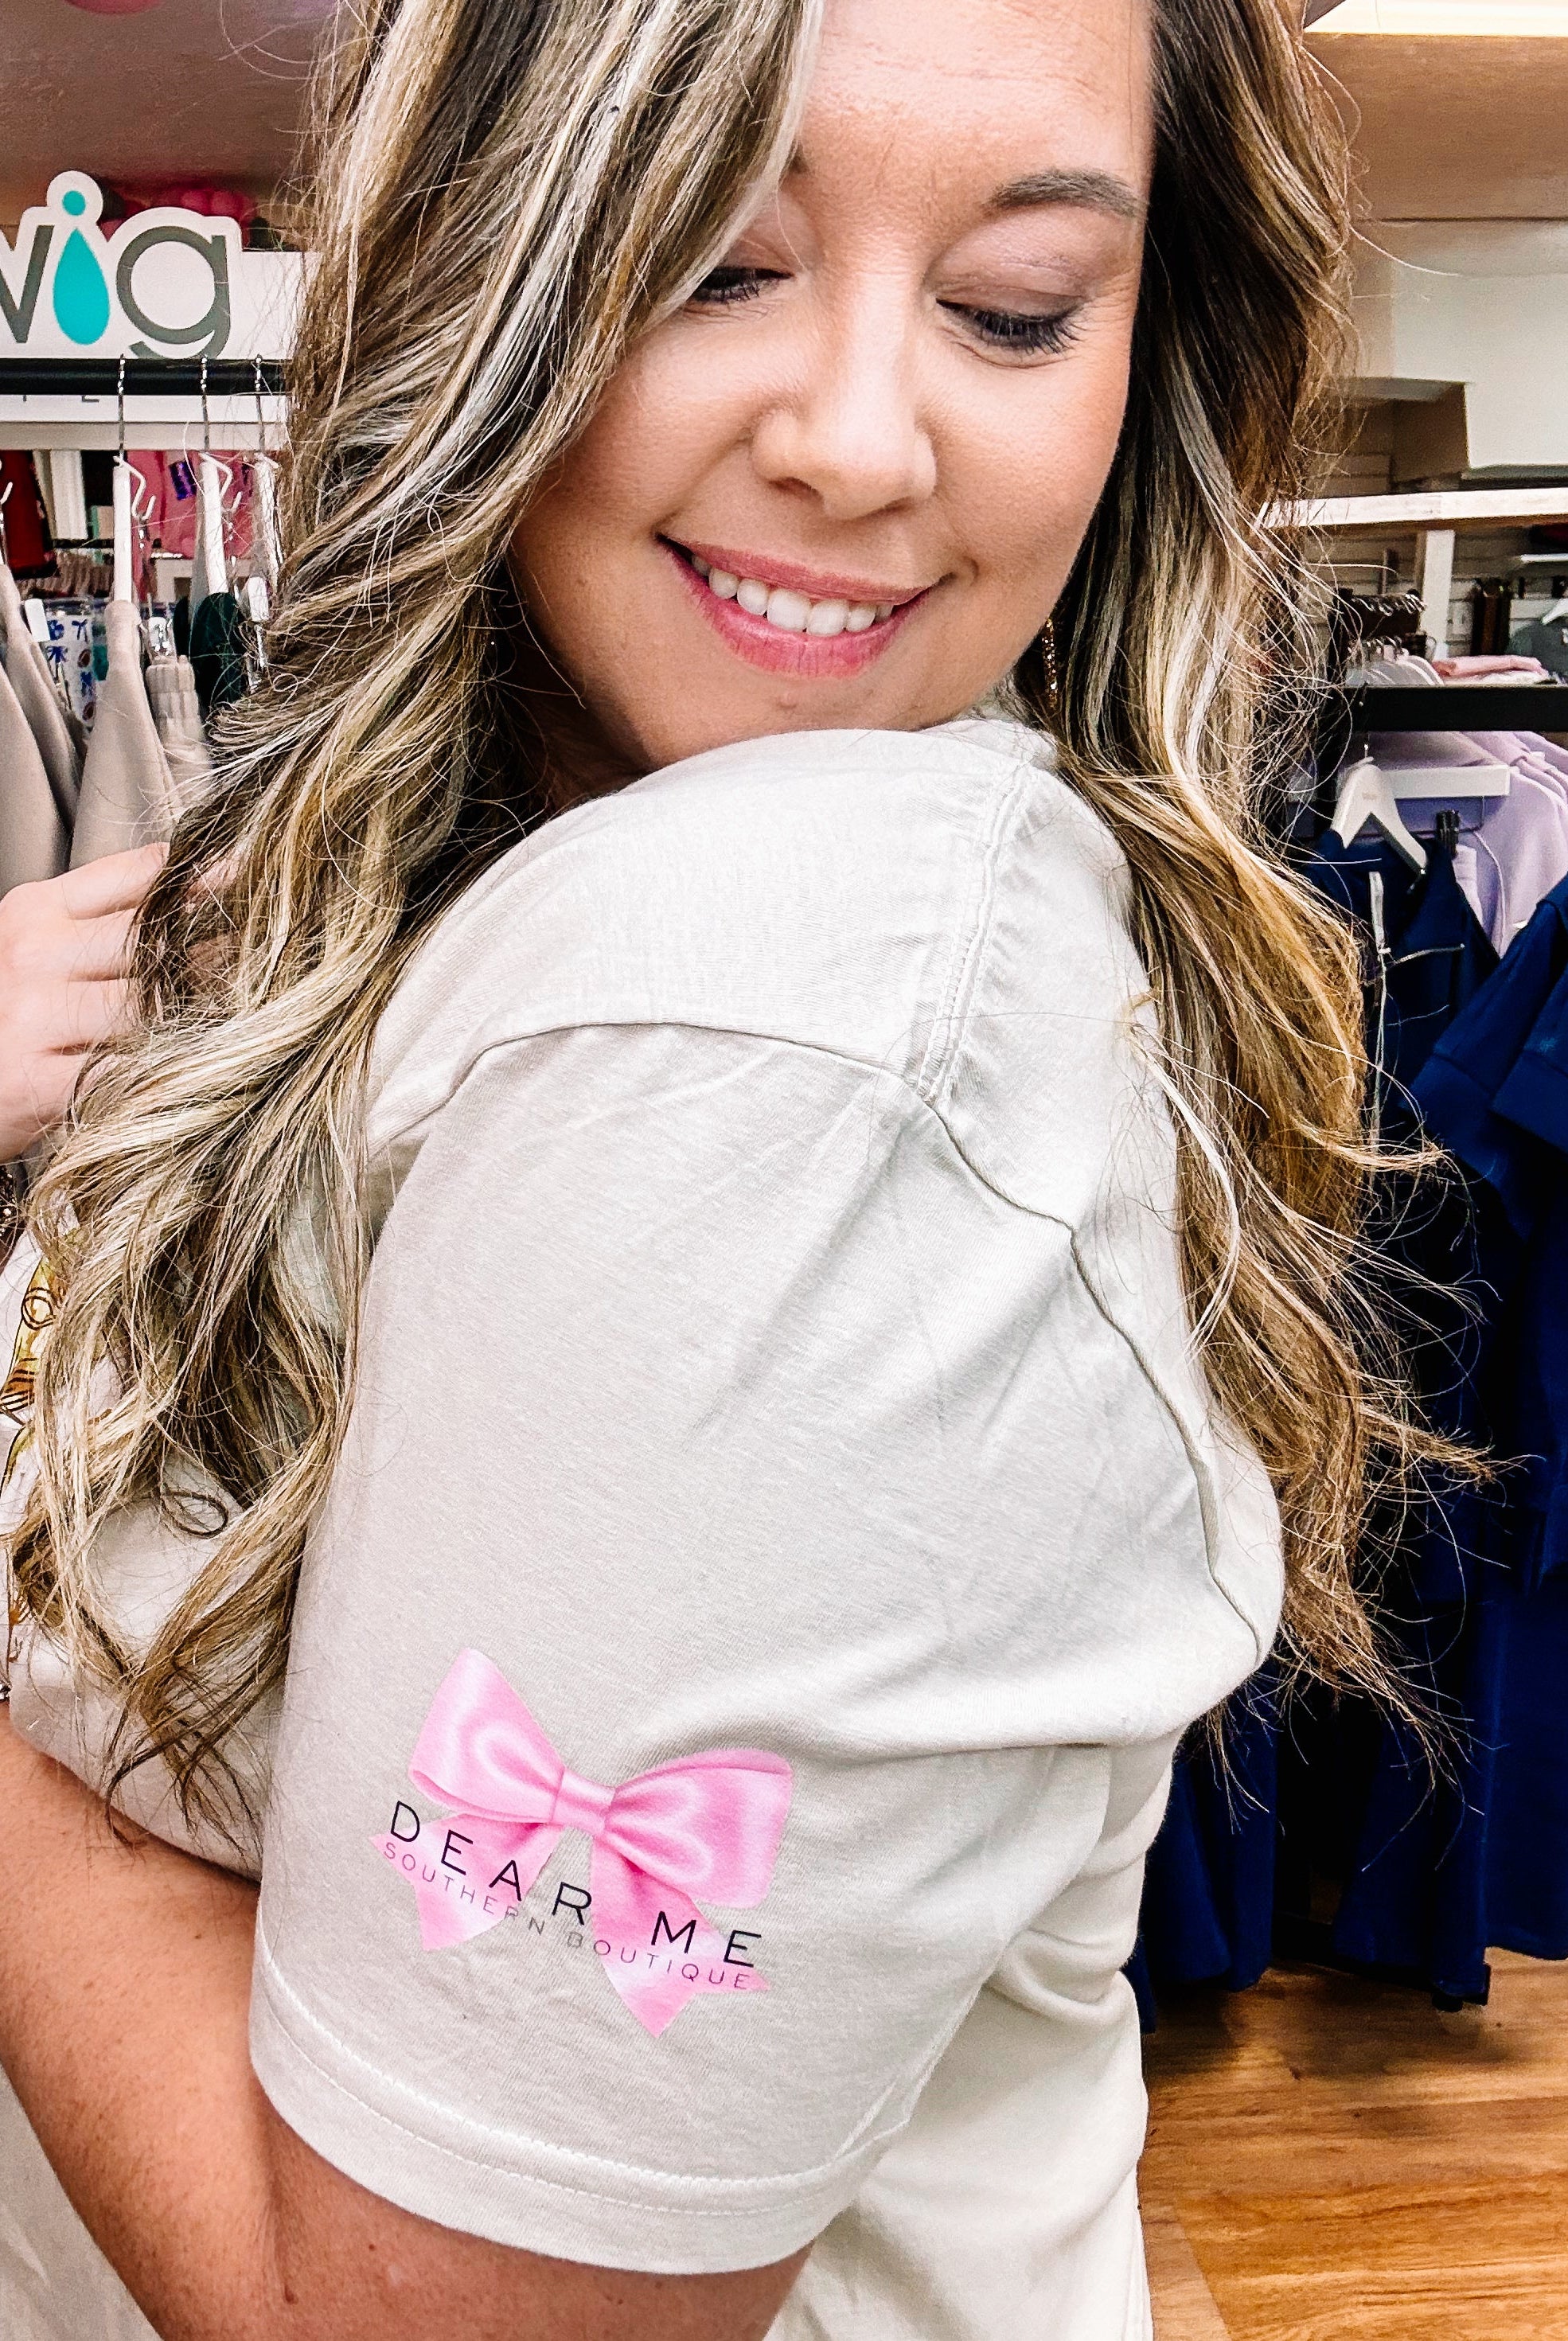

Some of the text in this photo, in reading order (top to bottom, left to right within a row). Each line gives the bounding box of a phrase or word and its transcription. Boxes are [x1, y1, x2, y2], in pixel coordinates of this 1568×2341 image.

[384, 1842, 751, 1990] SOUTHERN BOUTIQUE
[390, 1801, 762, 1968] DEAR ME
